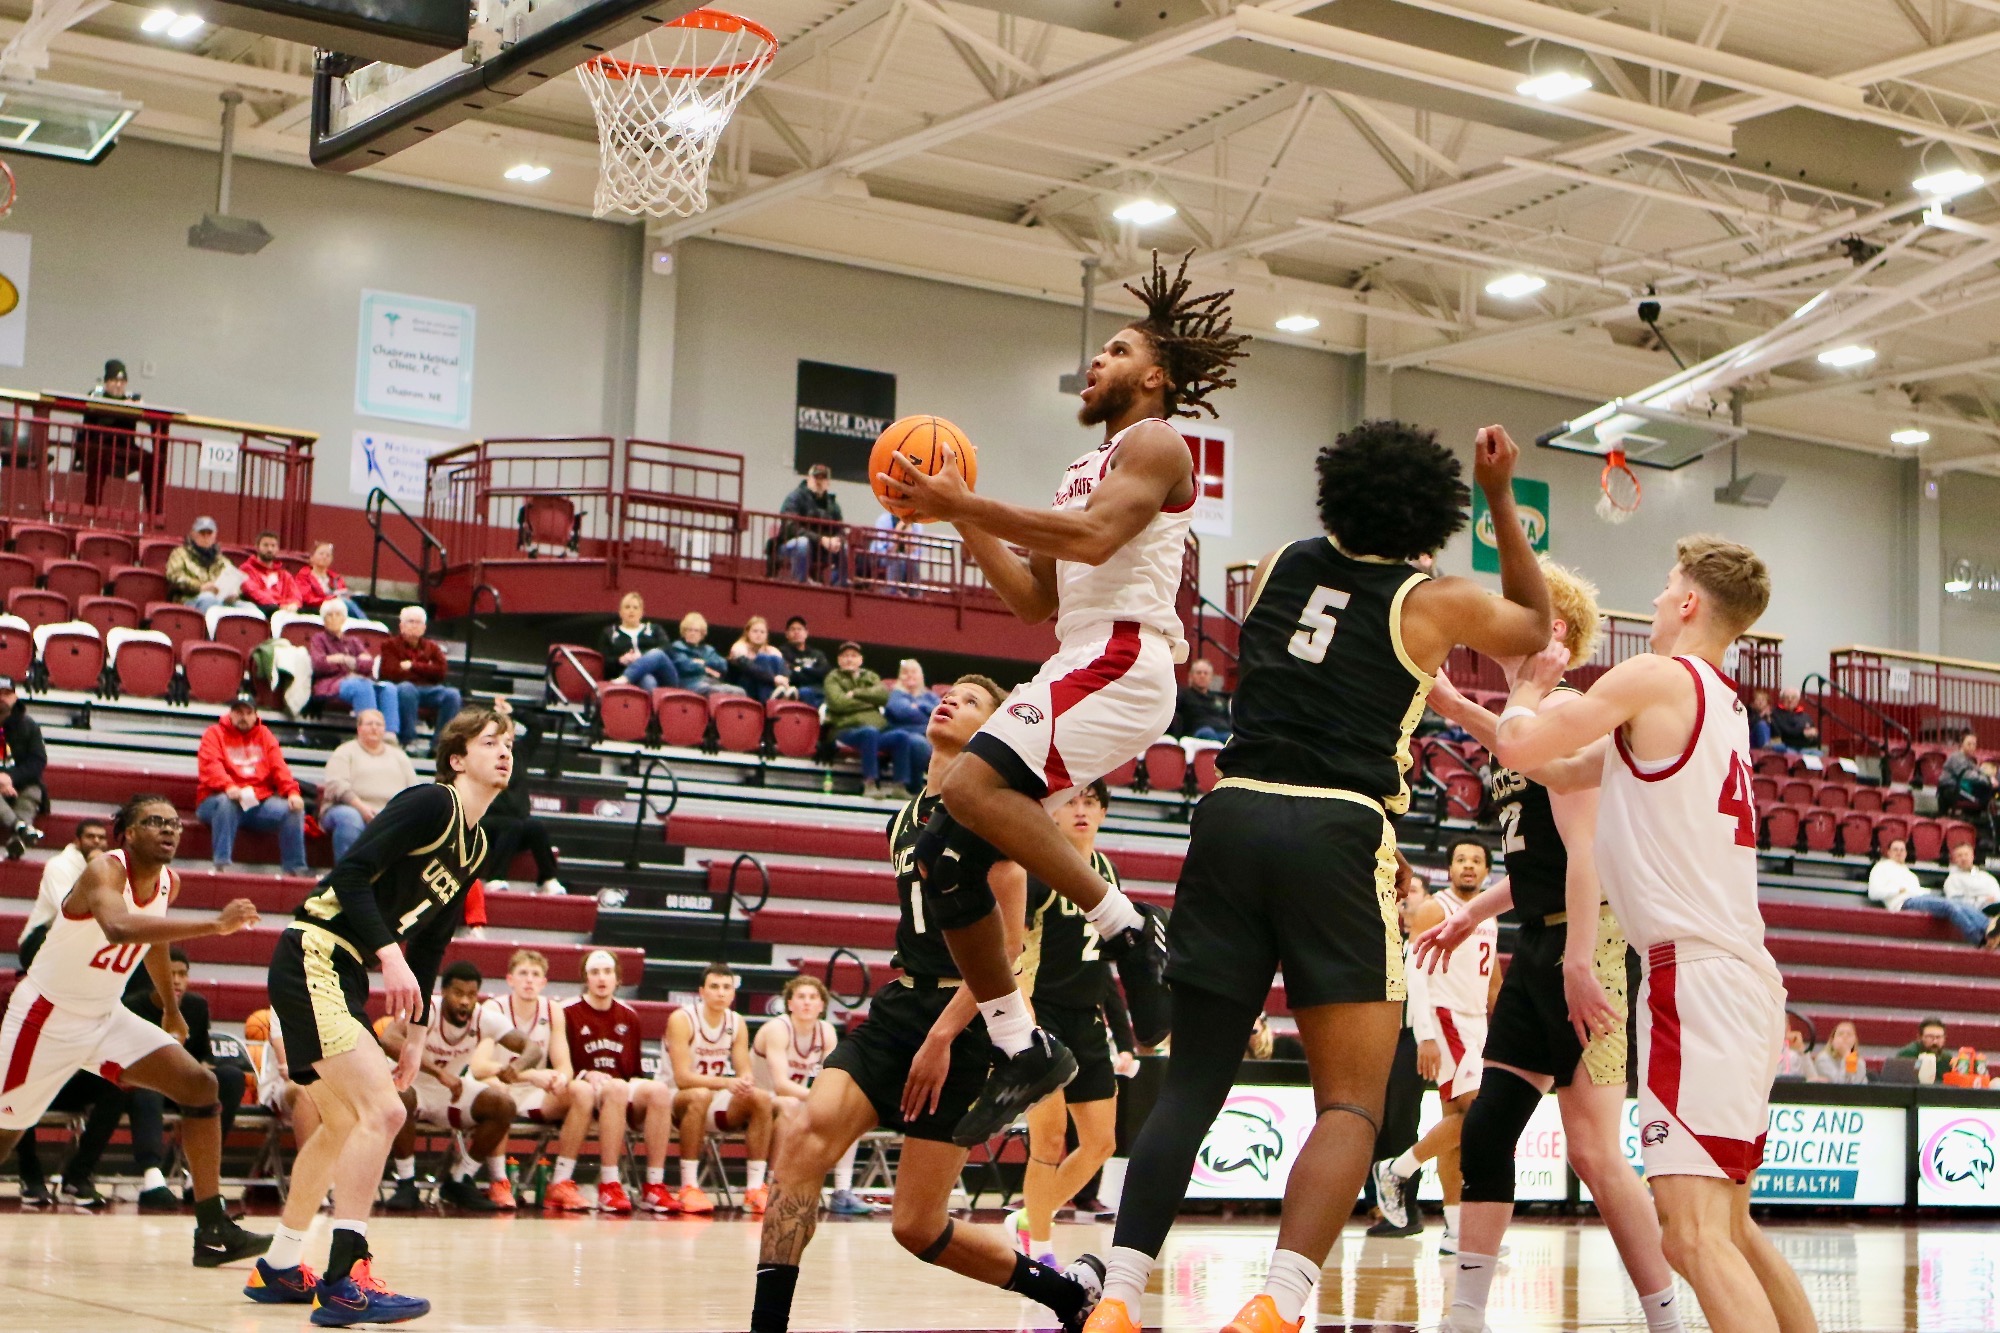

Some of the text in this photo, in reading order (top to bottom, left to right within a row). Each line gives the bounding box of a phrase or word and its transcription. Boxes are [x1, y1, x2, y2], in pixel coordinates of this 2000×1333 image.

[855, 416, 886, 433] DAY
[209, 447, 234, 462] 102
[1287, 584, 1351, 664] 5
[397, 898, 433, 935] 4
[910, 880, 927, 935] 1
[89, 943, 142, 974] 20
[1479, 942, 1490, 976] 2
[1812, 1110, 1864, 1135] AND
[1763, 1139, 1861, 1165] EDICINE
[1773, 1174, 1840, 1193] HEALTH
